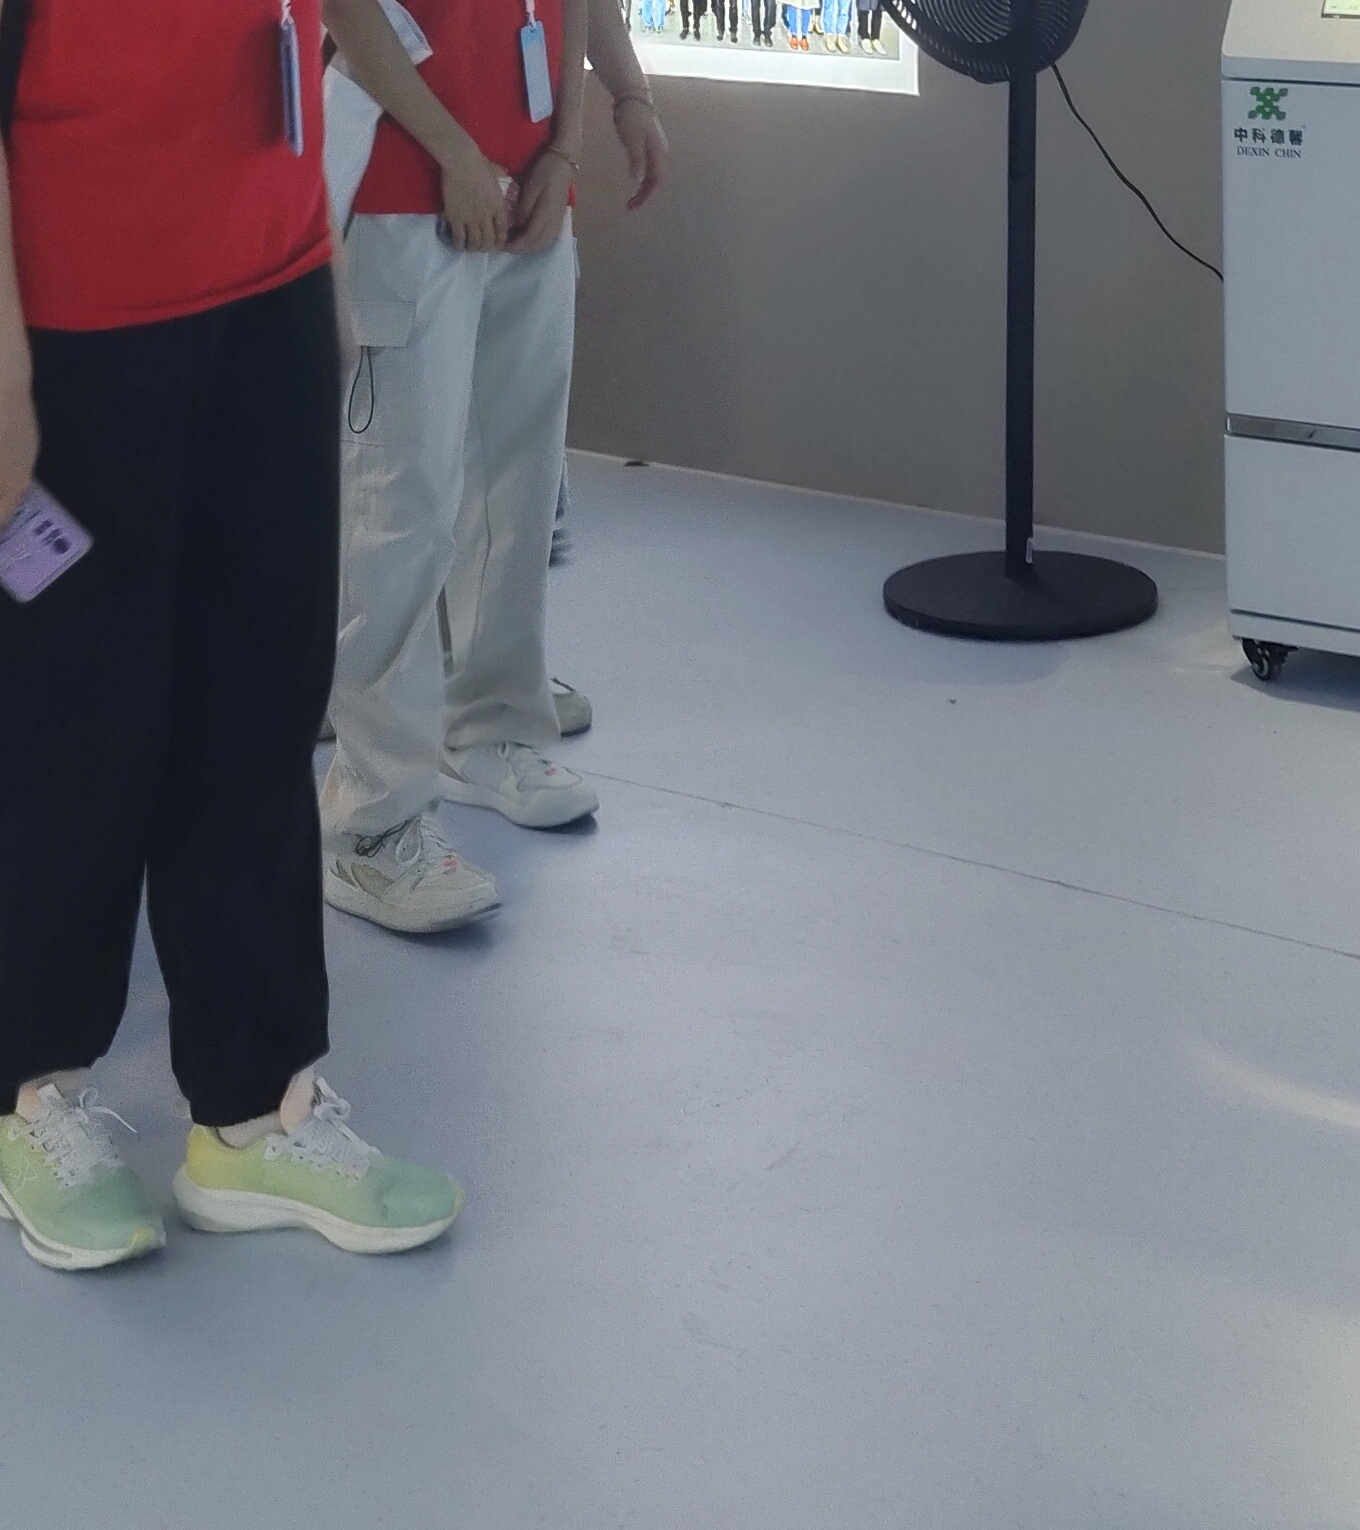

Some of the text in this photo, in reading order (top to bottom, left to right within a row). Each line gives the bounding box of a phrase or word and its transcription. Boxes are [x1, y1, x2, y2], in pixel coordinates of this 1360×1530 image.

[1233, 126, 1304, 146] 中科德馨
[1237, 146, 1302, 159] DEXIN CHIN
